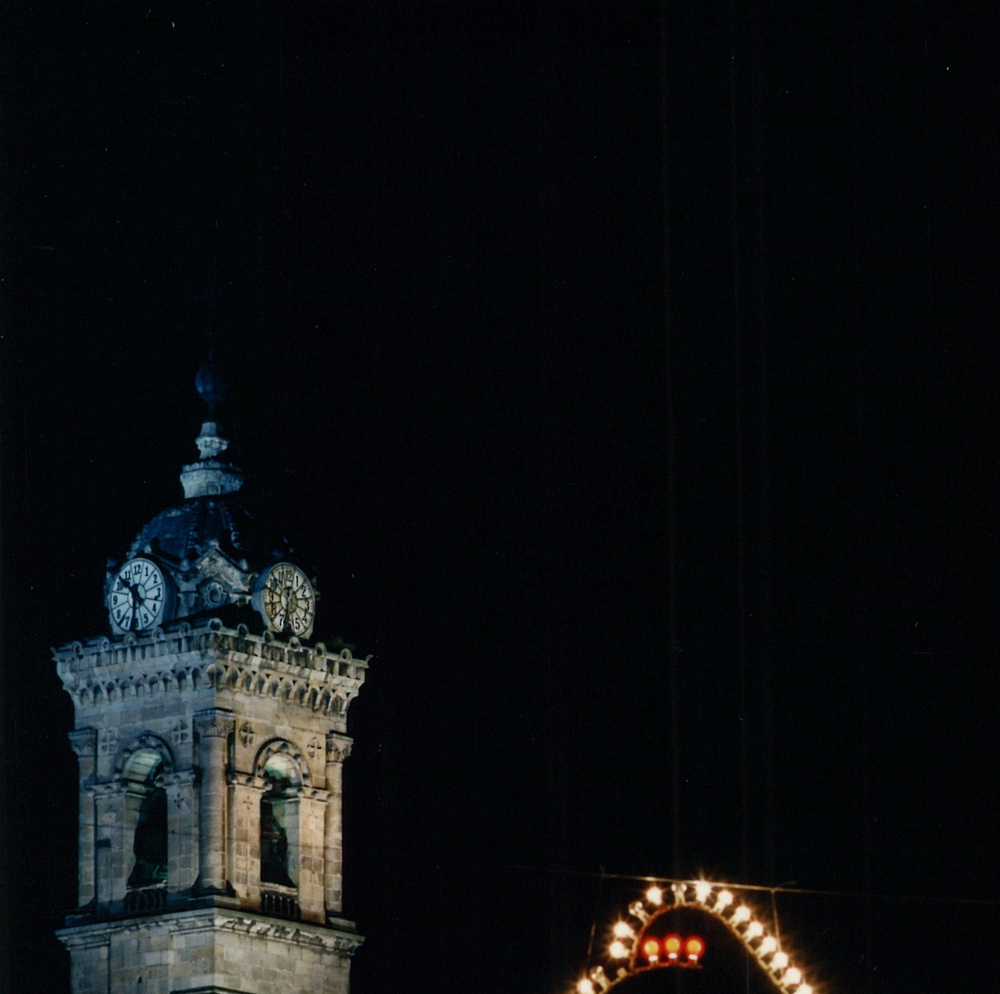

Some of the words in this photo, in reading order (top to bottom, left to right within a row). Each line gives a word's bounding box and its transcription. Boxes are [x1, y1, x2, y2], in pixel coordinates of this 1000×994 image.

[124, 570, 132, 580] 11
[134, 564, 141, 575] 12
[145, 567, 149, 577] 1
[153, 574, 158, 584] 2
[301, 585, 307, 597] 2
[113, 595, 118, 606] 9
[152, 603, 157, 613] 4
[116, 609, 121, 619] 8
[143, 613, 149, 624] 5
[279, 613, 285, 626] 7
[125, 616, 130, 627] 7
[295, 617, 300, 630] 5
